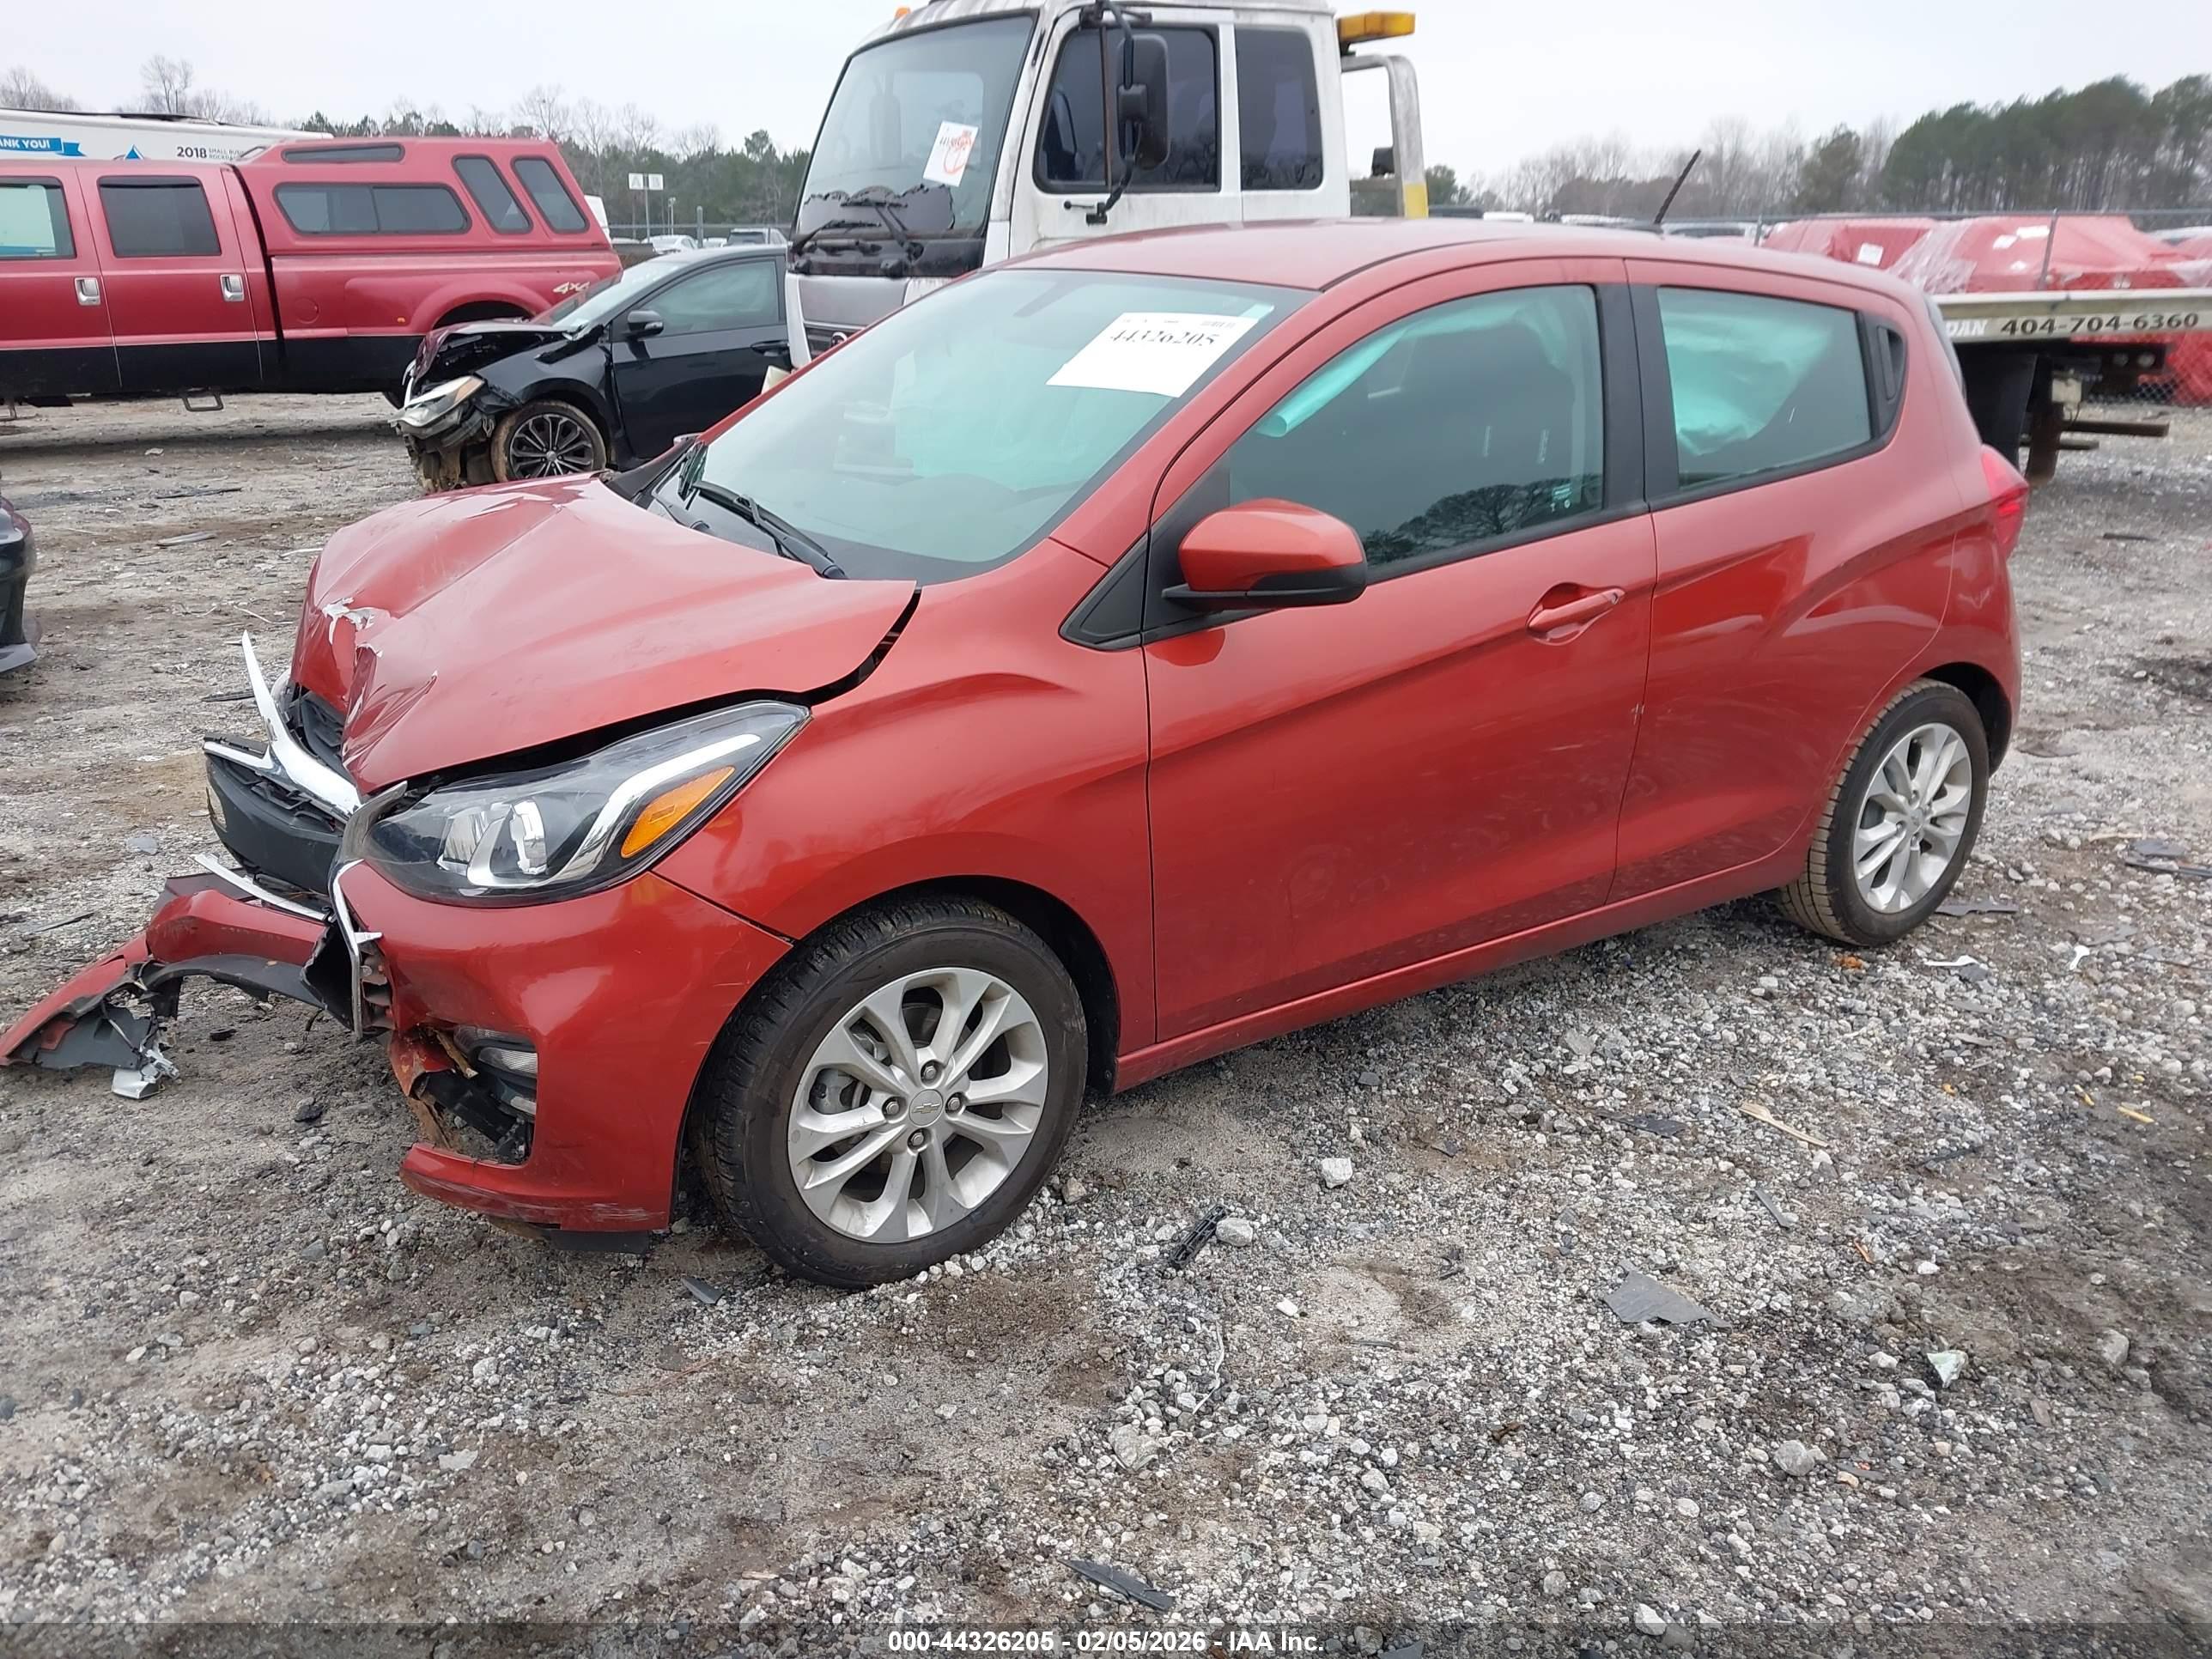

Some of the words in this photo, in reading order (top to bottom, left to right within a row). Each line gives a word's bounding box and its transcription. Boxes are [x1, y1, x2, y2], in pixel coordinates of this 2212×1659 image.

[21, 139, 51, 149] YOU!
[177, 146, 207, 159] 2018
[2000, 313, 2199, 336] 404-704-6360
